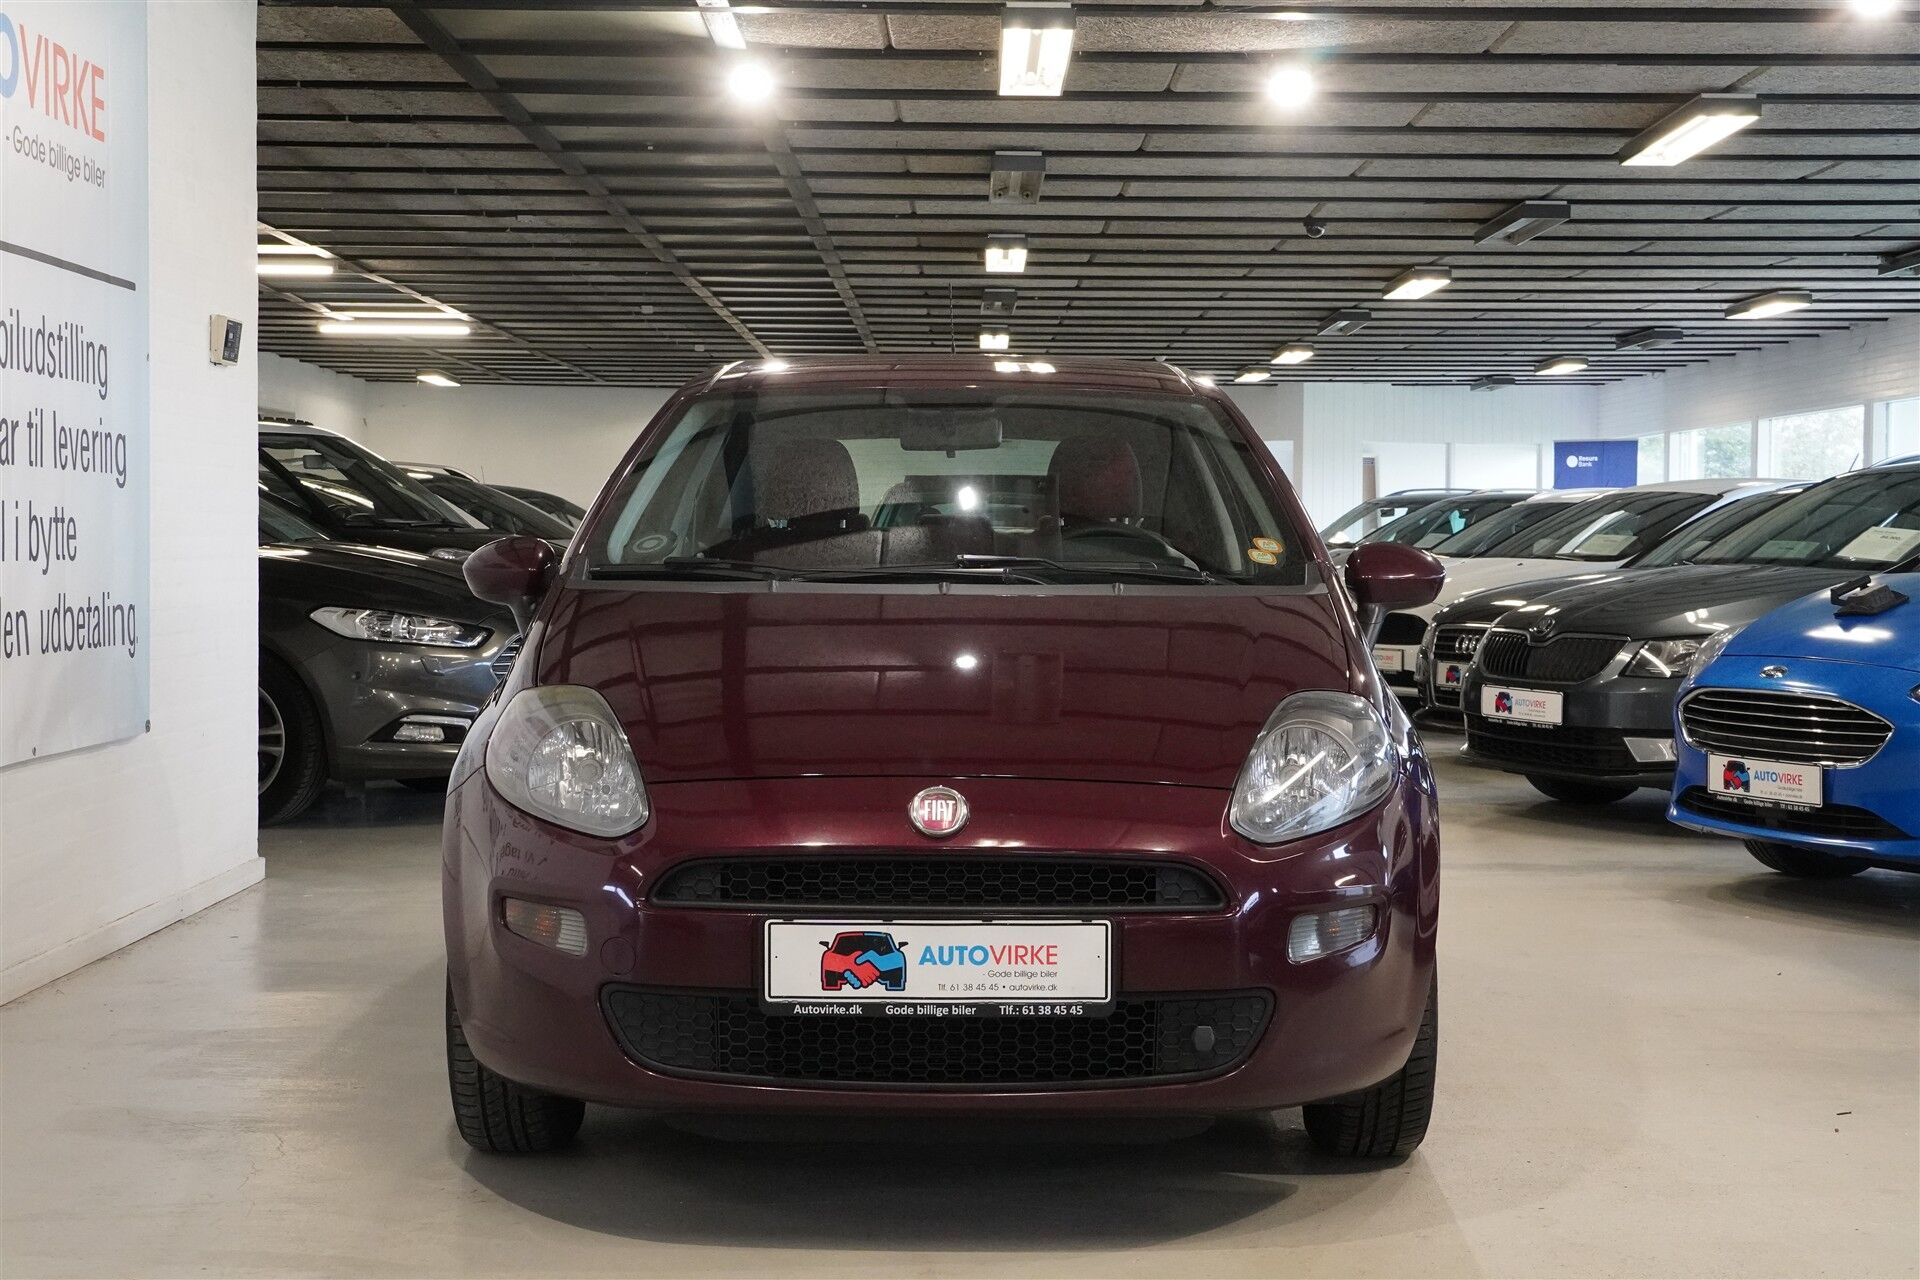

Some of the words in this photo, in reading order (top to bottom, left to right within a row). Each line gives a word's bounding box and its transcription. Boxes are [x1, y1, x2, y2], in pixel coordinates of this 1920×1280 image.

[13, 125, 46, 163] Gode
[49, 140, 81, 182] billige
[84, 155, 105, 188] biler
[27, 407, 43, 468] til
[53, 410, 126, 488] levering
[15, 500, 19, 561] i
[29, 500, 76, 575] bytte
[0, 592, 29, 659] en
[1753, 770, 1803, 786] AUTOVIRKE
[924, 799, 956, 821] FIAT
[918, 944, 1058, 966] AUTOVIRKE
[987, 969, 1012, 978] Gode
[1014, 969, 1038, 980] billige
[1040, 969, 1058, 978] biler
[950, 983, 960, 991] 61
[963, 983, 974, 991] 38
[976, 983, 986, 991] 45
[988, 983, 999, 991] 45
[1009, 982, 1058, 991] autovirke.dk
[793, 1004, 863, 1015] Autovirke.dk
[885, 1005, 914, 1015] Gode
[917, 1004, 949, 1017] billige
[951, 1004, 977, 1015] biler
[999, 1005, 1020, 1015] Tlf.:
[1022, 1005, 1035, 1015] 61
[1038, 1005, 1051, 1015] 38
[1053, 1005, 1067, 1015] 45
[1069, 1005, 1083, 1015] 45
